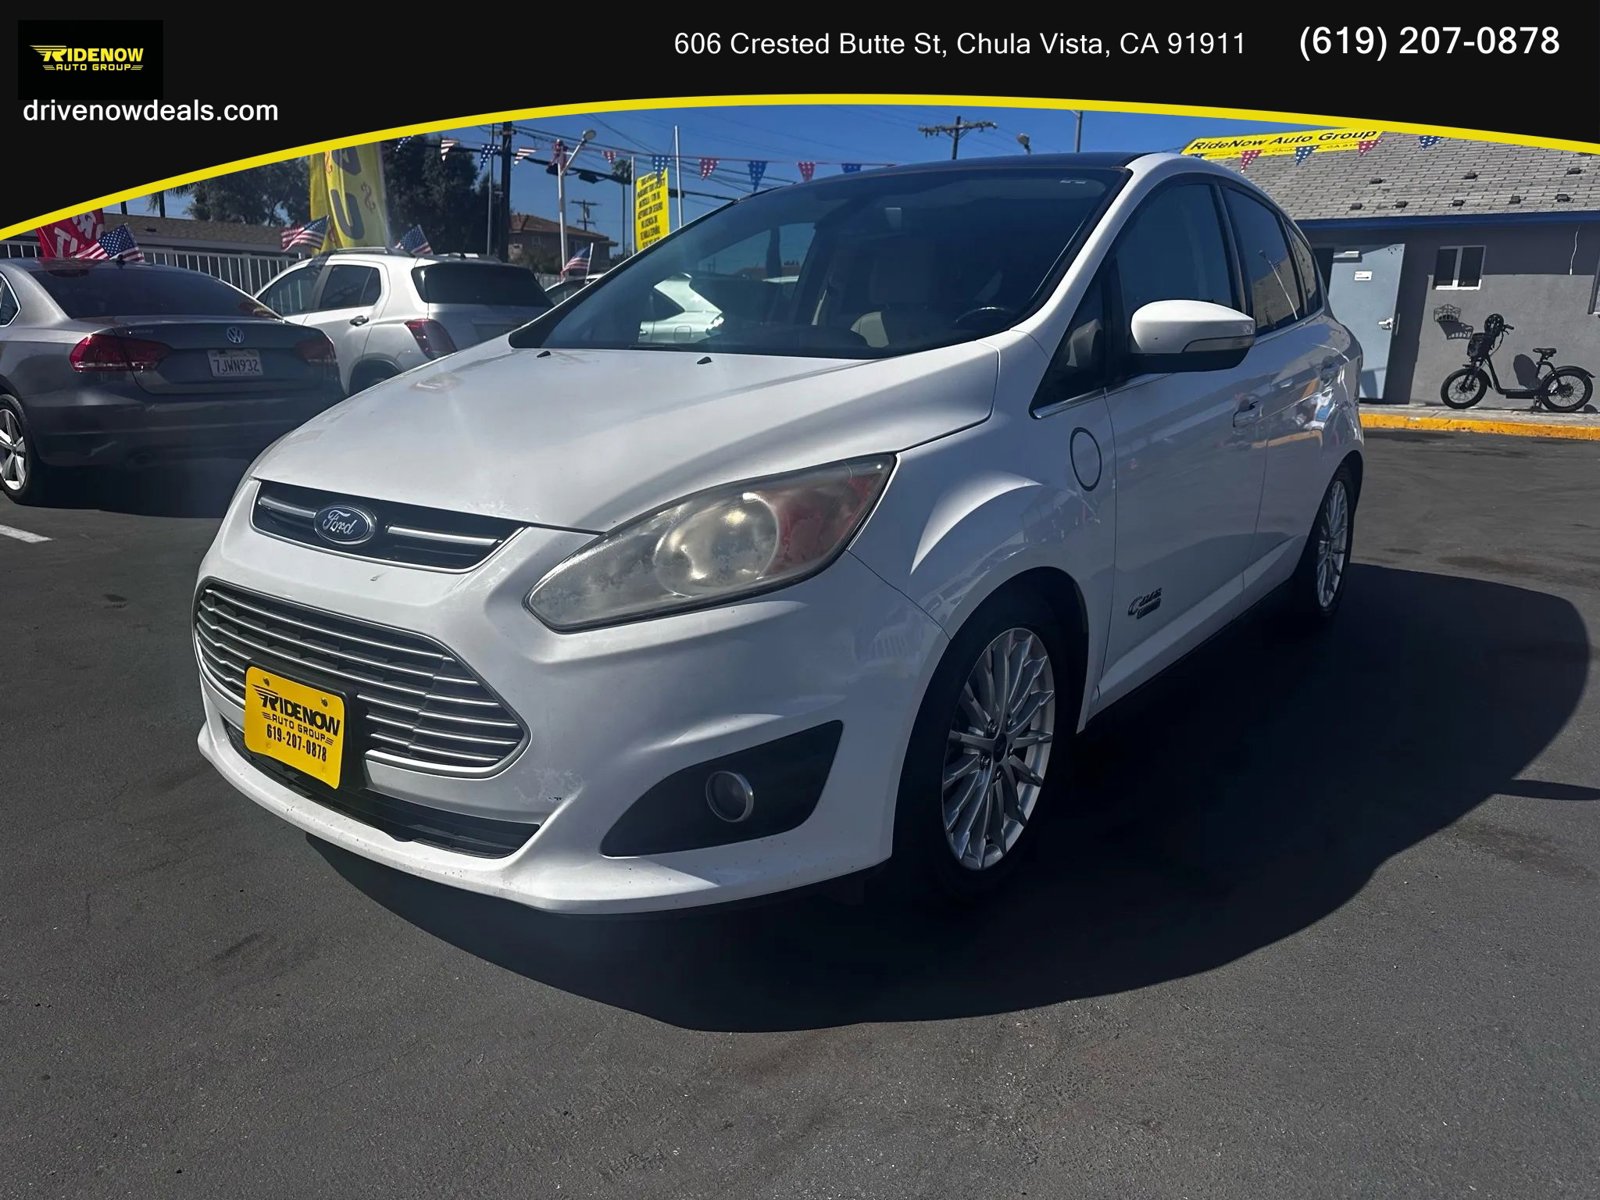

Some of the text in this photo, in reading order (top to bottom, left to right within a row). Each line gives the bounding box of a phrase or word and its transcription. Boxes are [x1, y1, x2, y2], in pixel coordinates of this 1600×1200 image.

[1190, 138, 1267, 151] RideNow
[1269, 134, 1313, 146] Auto
[1318, 130, 1378, 141] Group
[322, 509, 358, 535] Ford
[255, 686, 341, 736] RIDENOW
[266, 724, 328, 763] 619-207-0878
[271, 713, 326, 744] AUTO GROUP
